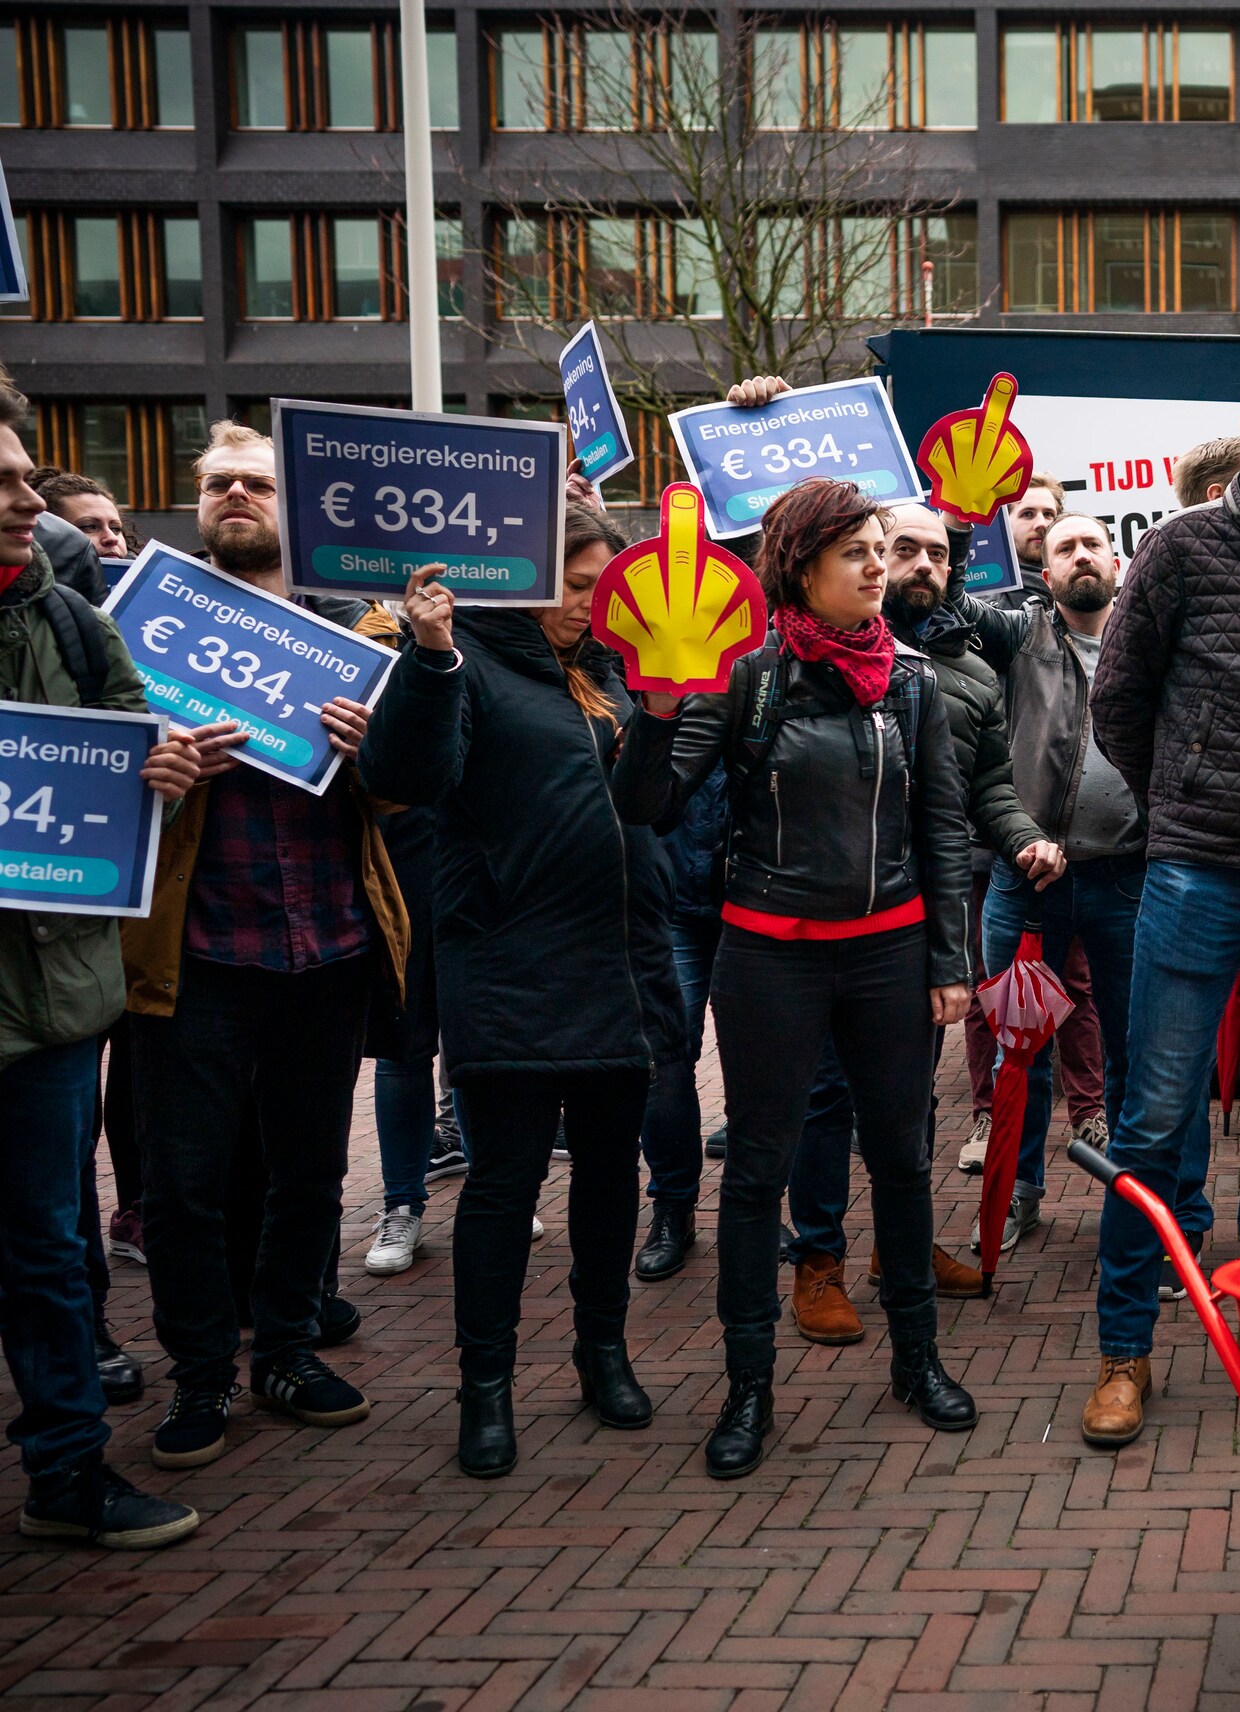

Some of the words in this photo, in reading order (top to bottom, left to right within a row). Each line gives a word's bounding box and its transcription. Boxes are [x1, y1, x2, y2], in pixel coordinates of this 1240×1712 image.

[563, 354, 594, 396] rekening
[568, 397, 600, 440] 34,-
[699, 401, 869, 441] Energierekening
[306, 433, 536, 479] Energierekening
[720, 449, 753, 480] €
[760, 433, 873, 474] 334,-
[1089, 458, 1154, 492] TIJD
[320, 481, 356, 528] €
[374, 485, 524, 546] 334,-
[340, 554, 395, 574] Shell:
[157, 572, 361, 683] Energierekening
[140, 615, 187, 654] €
[187, 635, 323, 719] 334,-
[186, 697, 214, 717] nu
[752, 670, 771, 728] DAKINE
[0, 861, 83, 883] etalen
